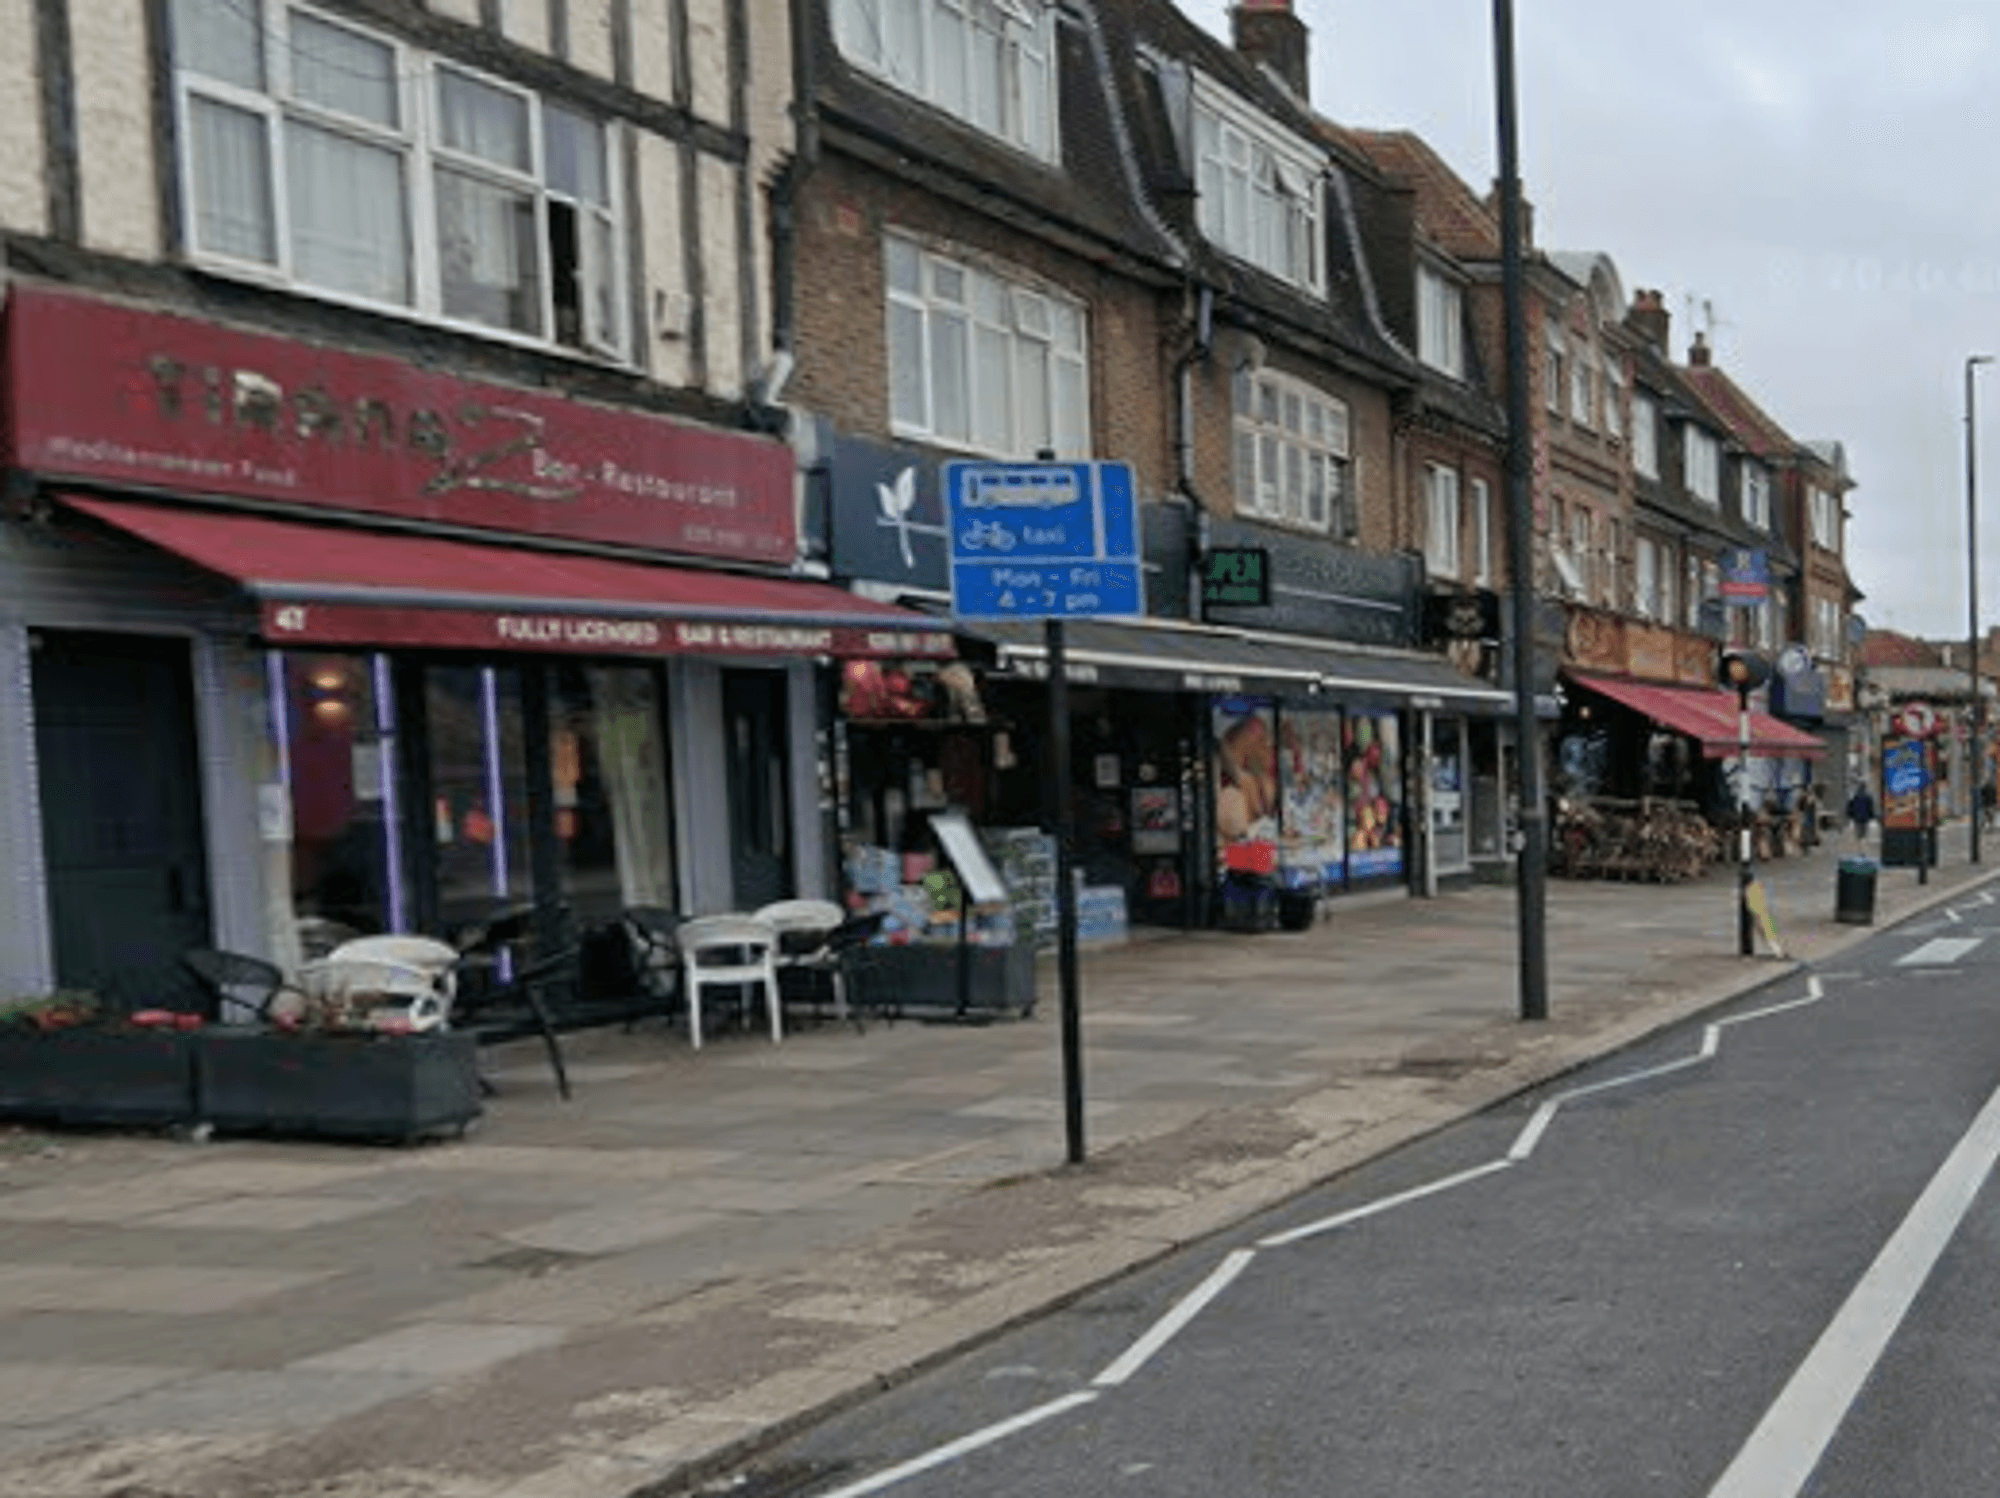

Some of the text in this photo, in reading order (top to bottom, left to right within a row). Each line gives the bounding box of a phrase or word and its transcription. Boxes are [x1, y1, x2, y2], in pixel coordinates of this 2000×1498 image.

[602, 459, 738, 509] Restaurant
[1022, 524, 1067, 546] taxi
[992, 567, 1043, 588] Mon
[1069, 567, 1100, 588] Fri
[1065, 593, 1099, 612] pm
[498, 616, 562, 643] FULLY
[564, 620, 658, 648] LICENSED
[677, 622, 712, 647] BAR
[734, 624, 832, 651] RESTAURANT
